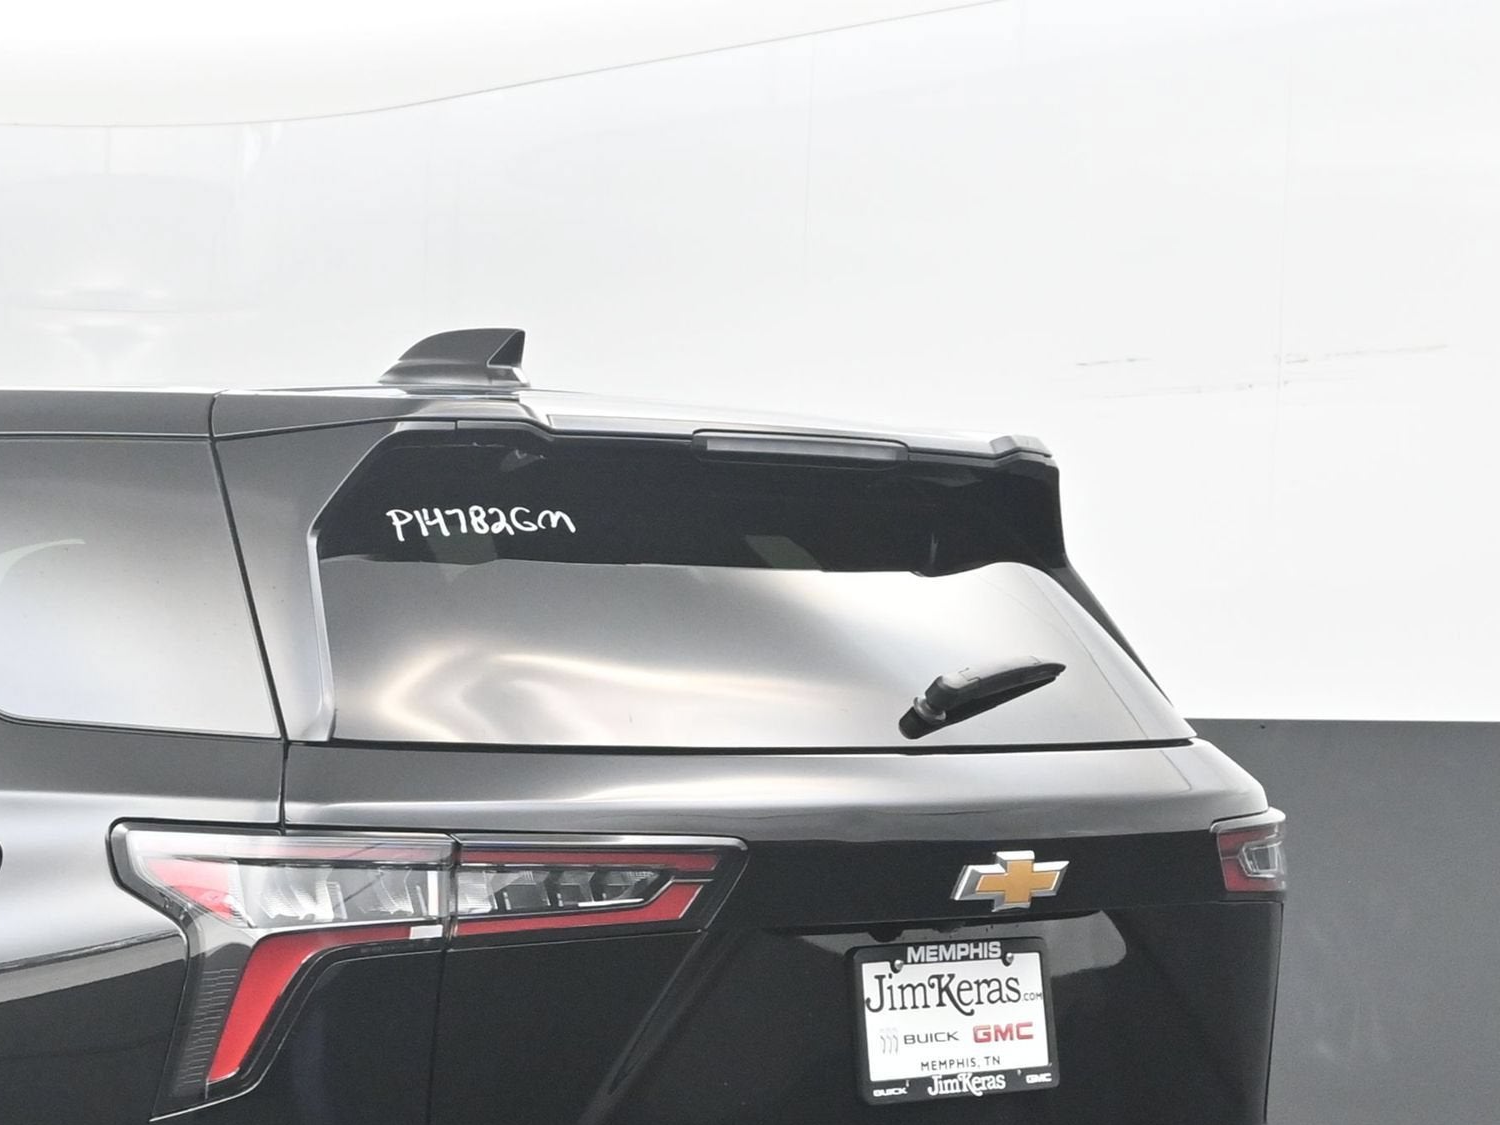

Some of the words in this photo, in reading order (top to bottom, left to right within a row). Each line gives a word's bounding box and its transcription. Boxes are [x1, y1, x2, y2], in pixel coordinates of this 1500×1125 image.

[907, 941, 1002, 963] MEMPHIS
[903, 1031, 960, 1045] BUICK
[973, 1022, 1034, 1043] GMC
[984, 1055, 1001, 1066] TN
